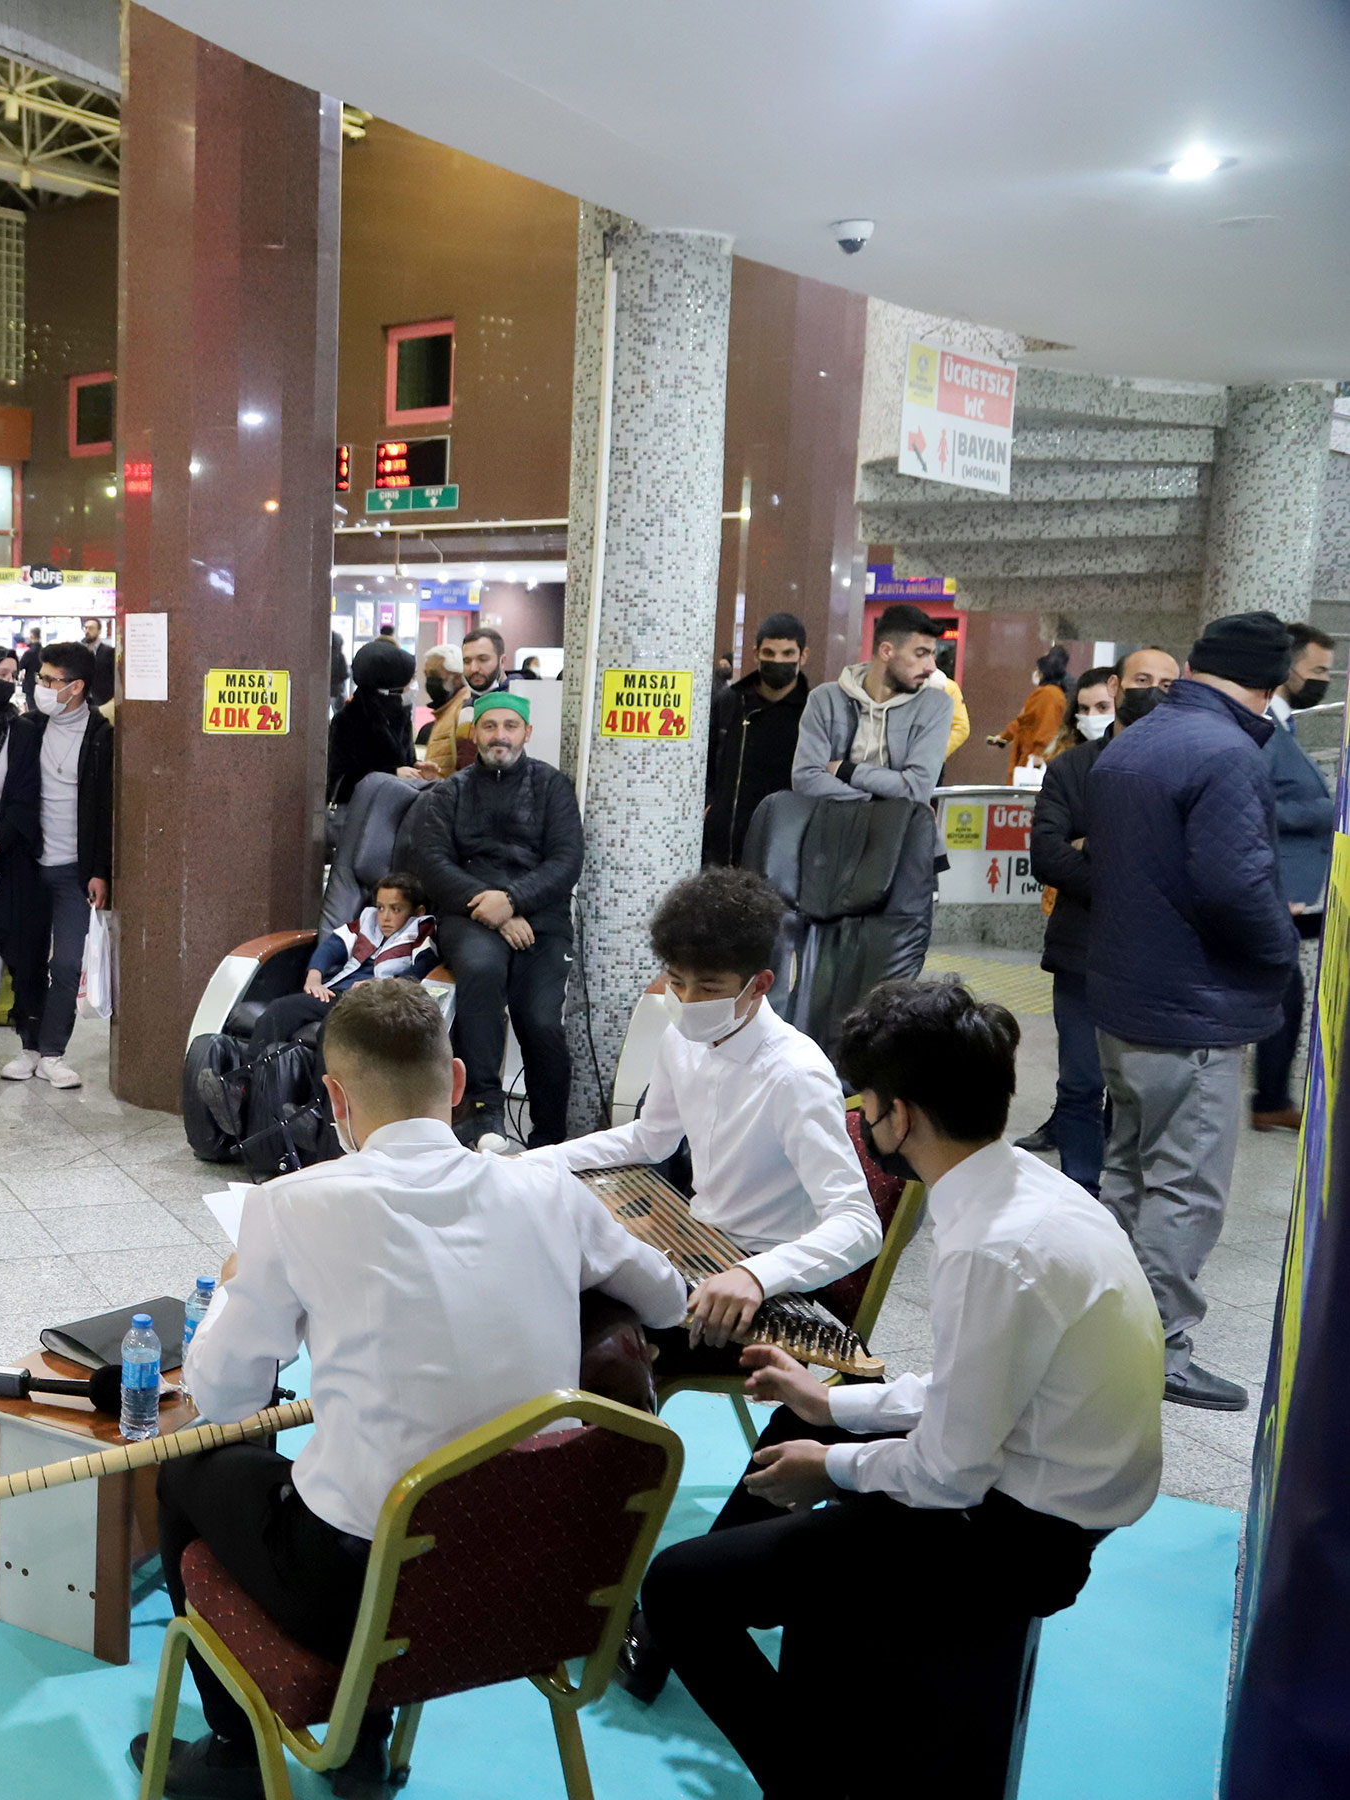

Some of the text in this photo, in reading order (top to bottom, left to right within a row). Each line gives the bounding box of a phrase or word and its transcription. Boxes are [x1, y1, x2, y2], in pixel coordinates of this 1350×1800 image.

[944, 353, 1011, 397] ÜCRETSİZ
[964, 394, 986, 419] WC
[958, 432, 1007, 465] BAYAN
[962, 463, 1001, 485] (WOMAN)
[424, 488, 444, 498] EXIT
[32, 568, 63, 585] BÜFE
[624, 674, 676, 689] MASAJ
[218, 689, 278, 705] KOLTUĞU
[615, 690, 681, 708] KOLTUĞU
